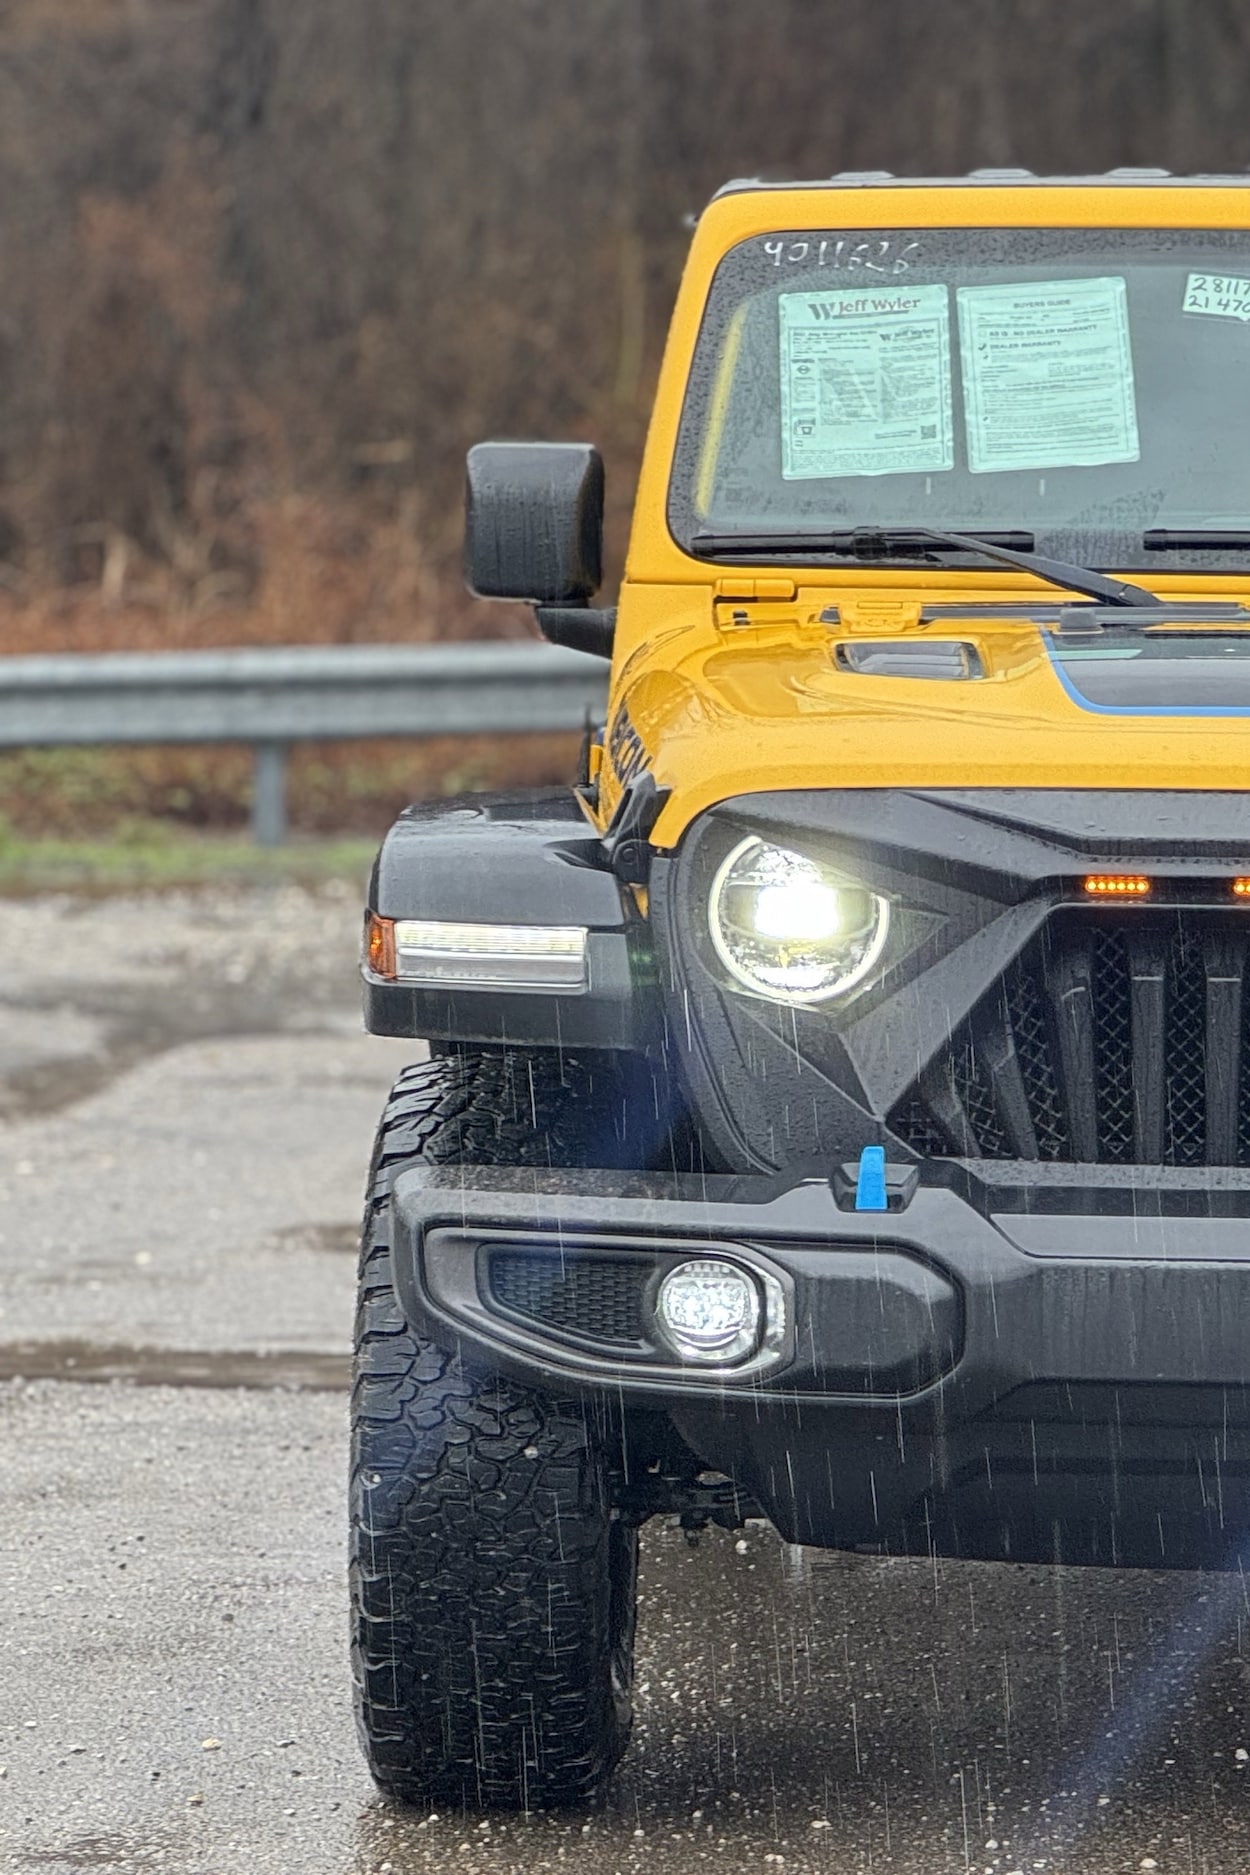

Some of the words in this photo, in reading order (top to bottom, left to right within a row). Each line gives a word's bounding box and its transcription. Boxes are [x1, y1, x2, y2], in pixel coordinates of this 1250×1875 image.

[838, 299, 869, 315] Jeff
[871, 297, 921, 313] Wyler
[1047, 299, 1071, 307] GUIDE
